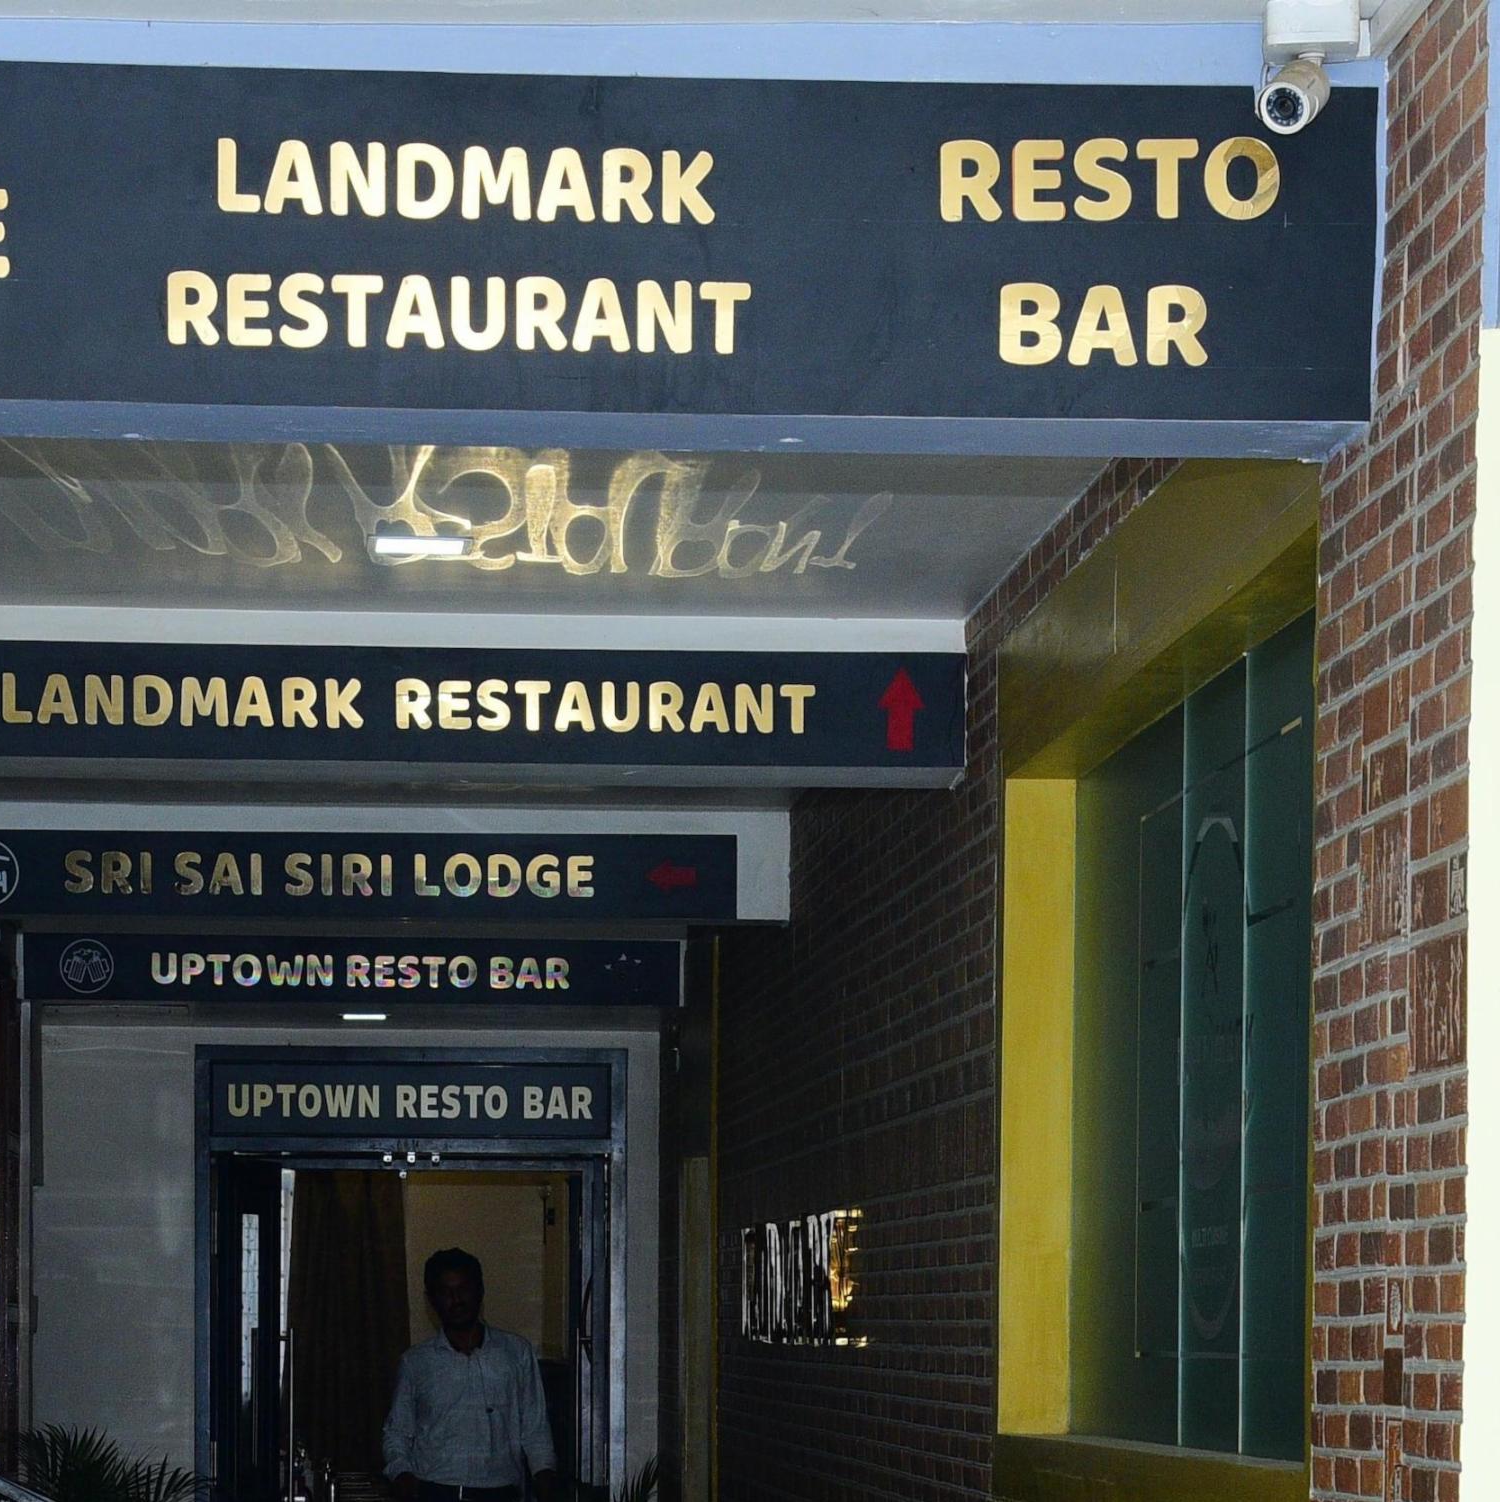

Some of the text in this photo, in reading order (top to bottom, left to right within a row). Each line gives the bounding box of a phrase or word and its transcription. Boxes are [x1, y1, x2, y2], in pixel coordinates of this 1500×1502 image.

[217, 137, 716, 225] LANDMARK
[939, 136, 1281, 223] RESTO
[166, 269, 752, 355] RESTAURANT
[998, 282, 1209, 367] BAR
[2, 672, 816, 735] LANDMARK RESTAURANT
[63, 850, 596, 899] SRI SAI SIRI LODGE
[150, 952, 571, 991] UPTOWN RESTO BAR
[228, 1084, 593, 1120] UPTOWN RESTO BAR
